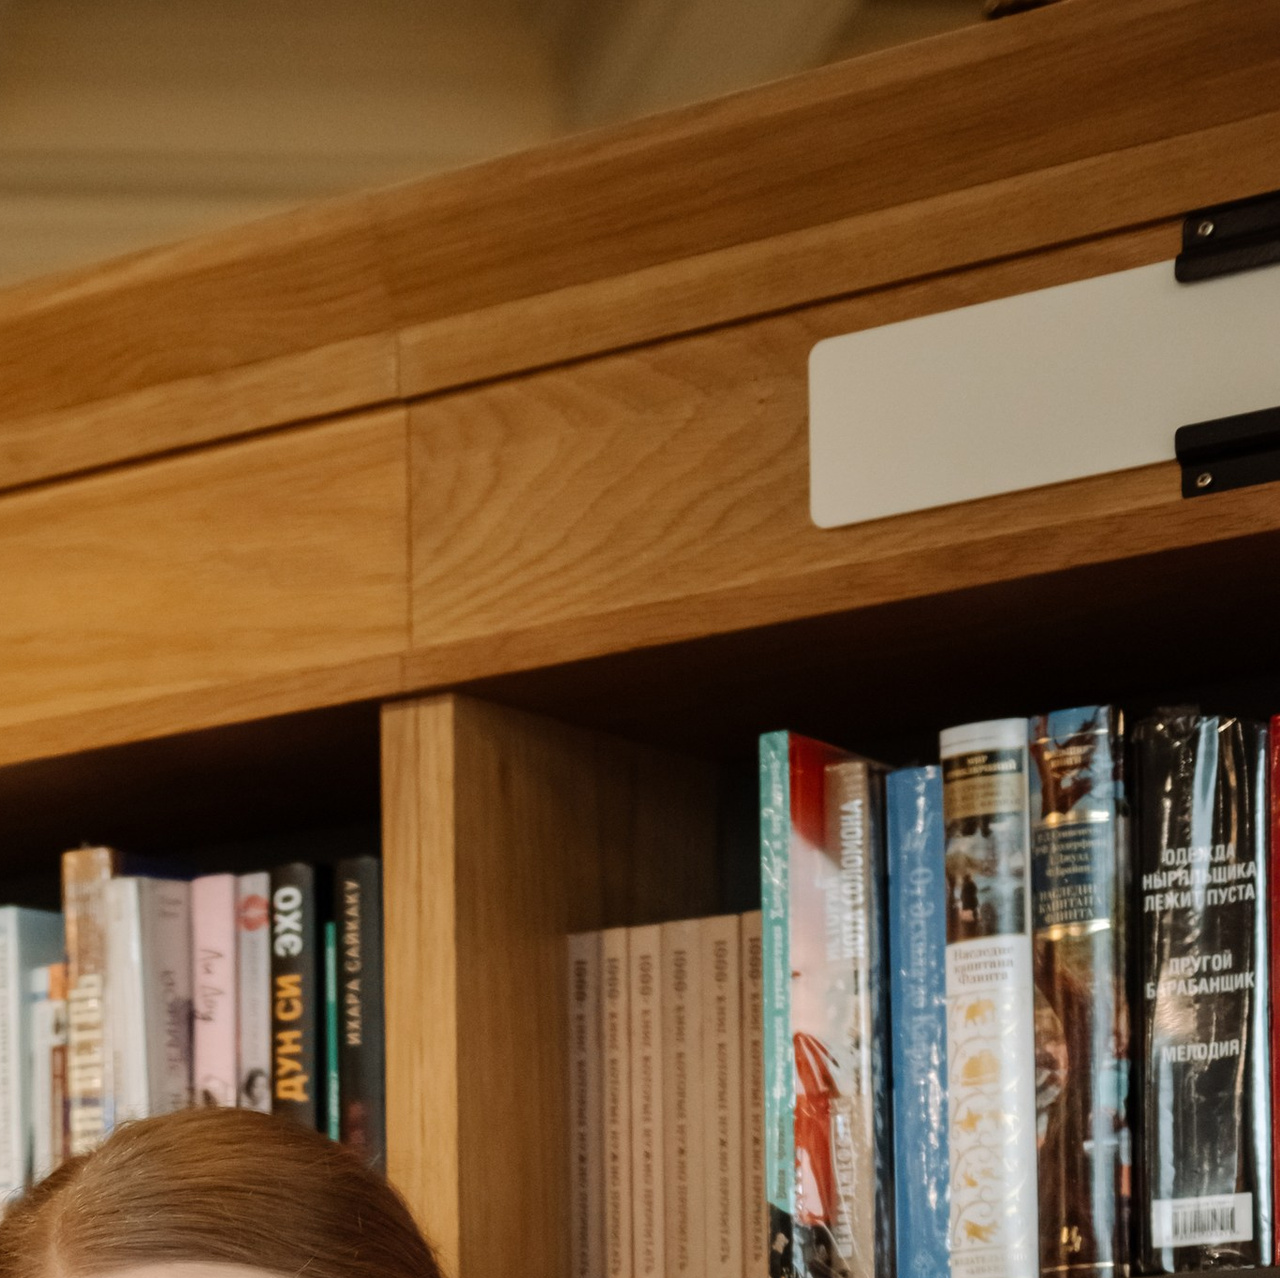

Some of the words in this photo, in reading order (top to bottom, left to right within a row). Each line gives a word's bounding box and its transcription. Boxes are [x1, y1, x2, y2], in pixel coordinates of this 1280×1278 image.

[840, 799, 864, 904] СОЛОМОНА
[1163, 844, 1236, 866] ОДЕЖДА
[1143, 862, 1257, 891] НЫРЯЛЬЩИКА
[1144, 893, 1204, 912] ЛЕЖИТ
[1207, 884, 1255, 905] ПУСТА
[273, 887, 303, 956] ЭХО
[342, 880, 361, 972] САЙКАКУ
[1170, 950, 1232, 974] ДРУГОЙ
[275, 974, 303, 1021] СИ
[1146, 972, 1254, 999] БАРАБАНЩИК
[346, 979, 362, 1045] ИХАРА
[275, 1030, 309, 1102] ДУН
[1163, 1039, 1239, 1063] МЕЛОДИЯ
